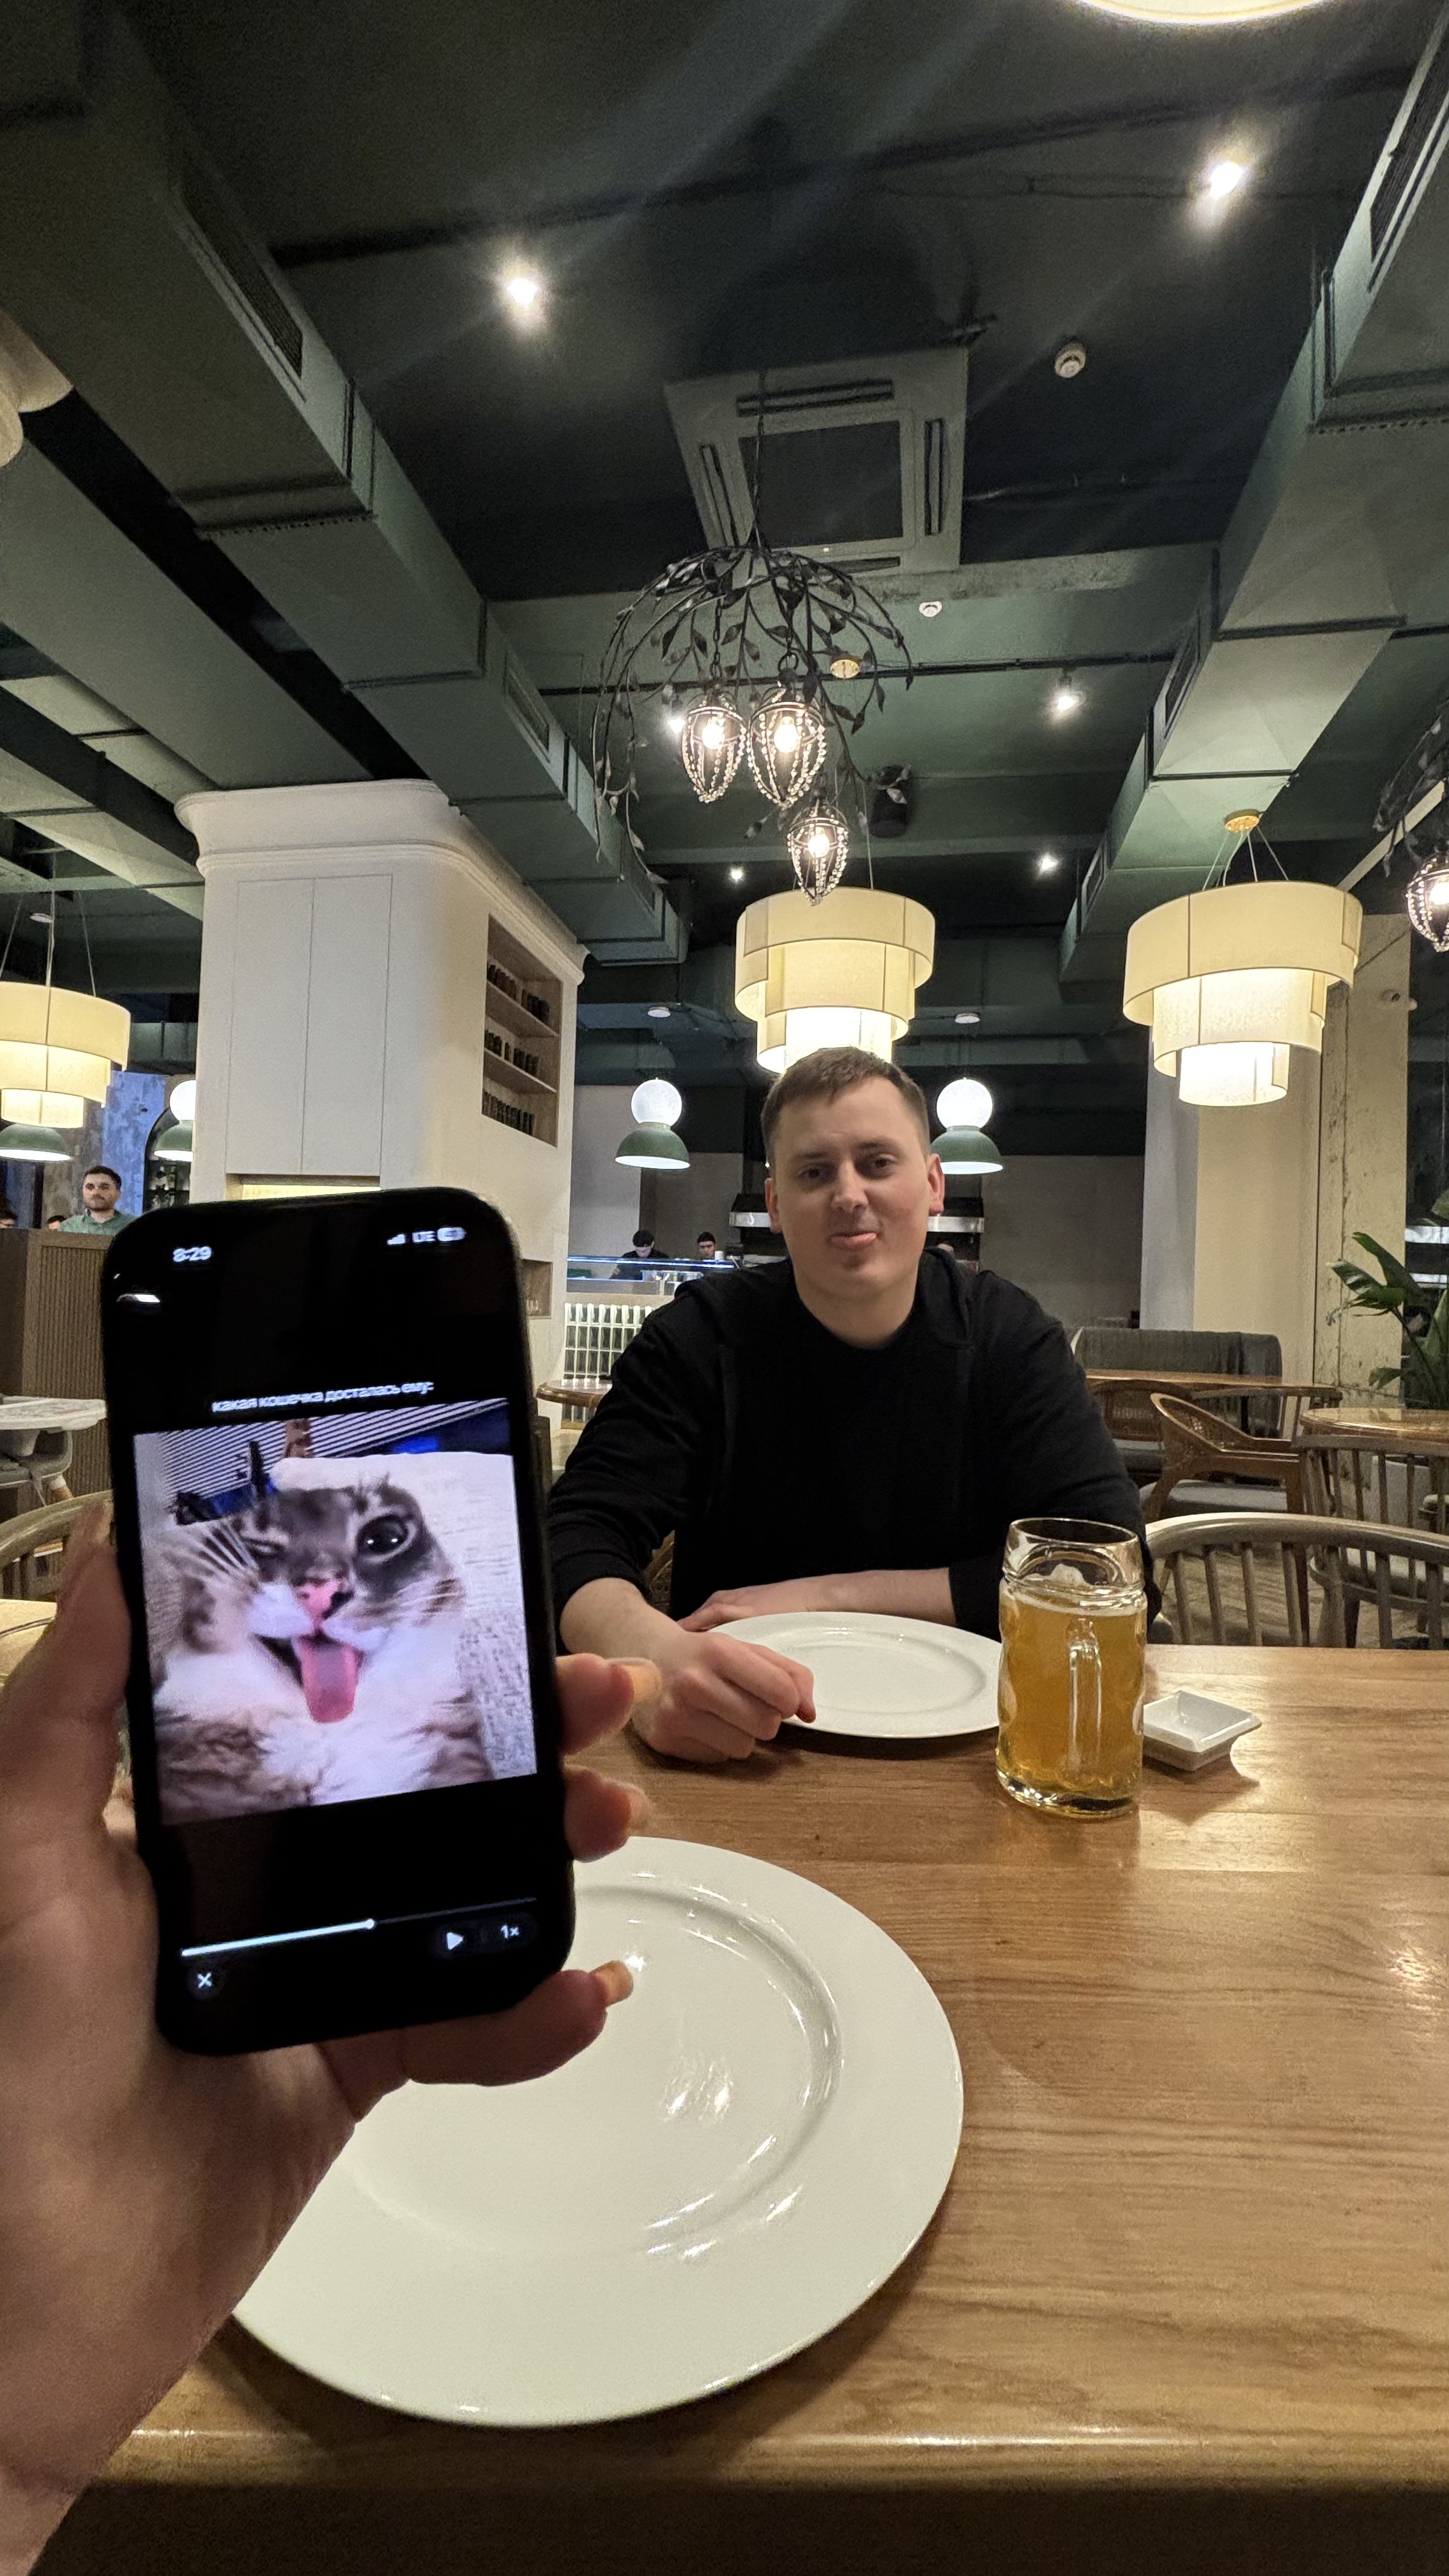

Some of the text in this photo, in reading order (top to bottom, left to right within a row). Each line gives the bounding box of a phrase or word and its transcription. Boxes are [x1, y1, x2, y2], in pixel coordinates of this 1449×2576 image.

[412, 1230, 435, 1243] LTE
[172, 1246, 211, 1262] 8:29
[211, 1398, 257, 1413] какая
[325, 1384, 401, 1403] досталась
